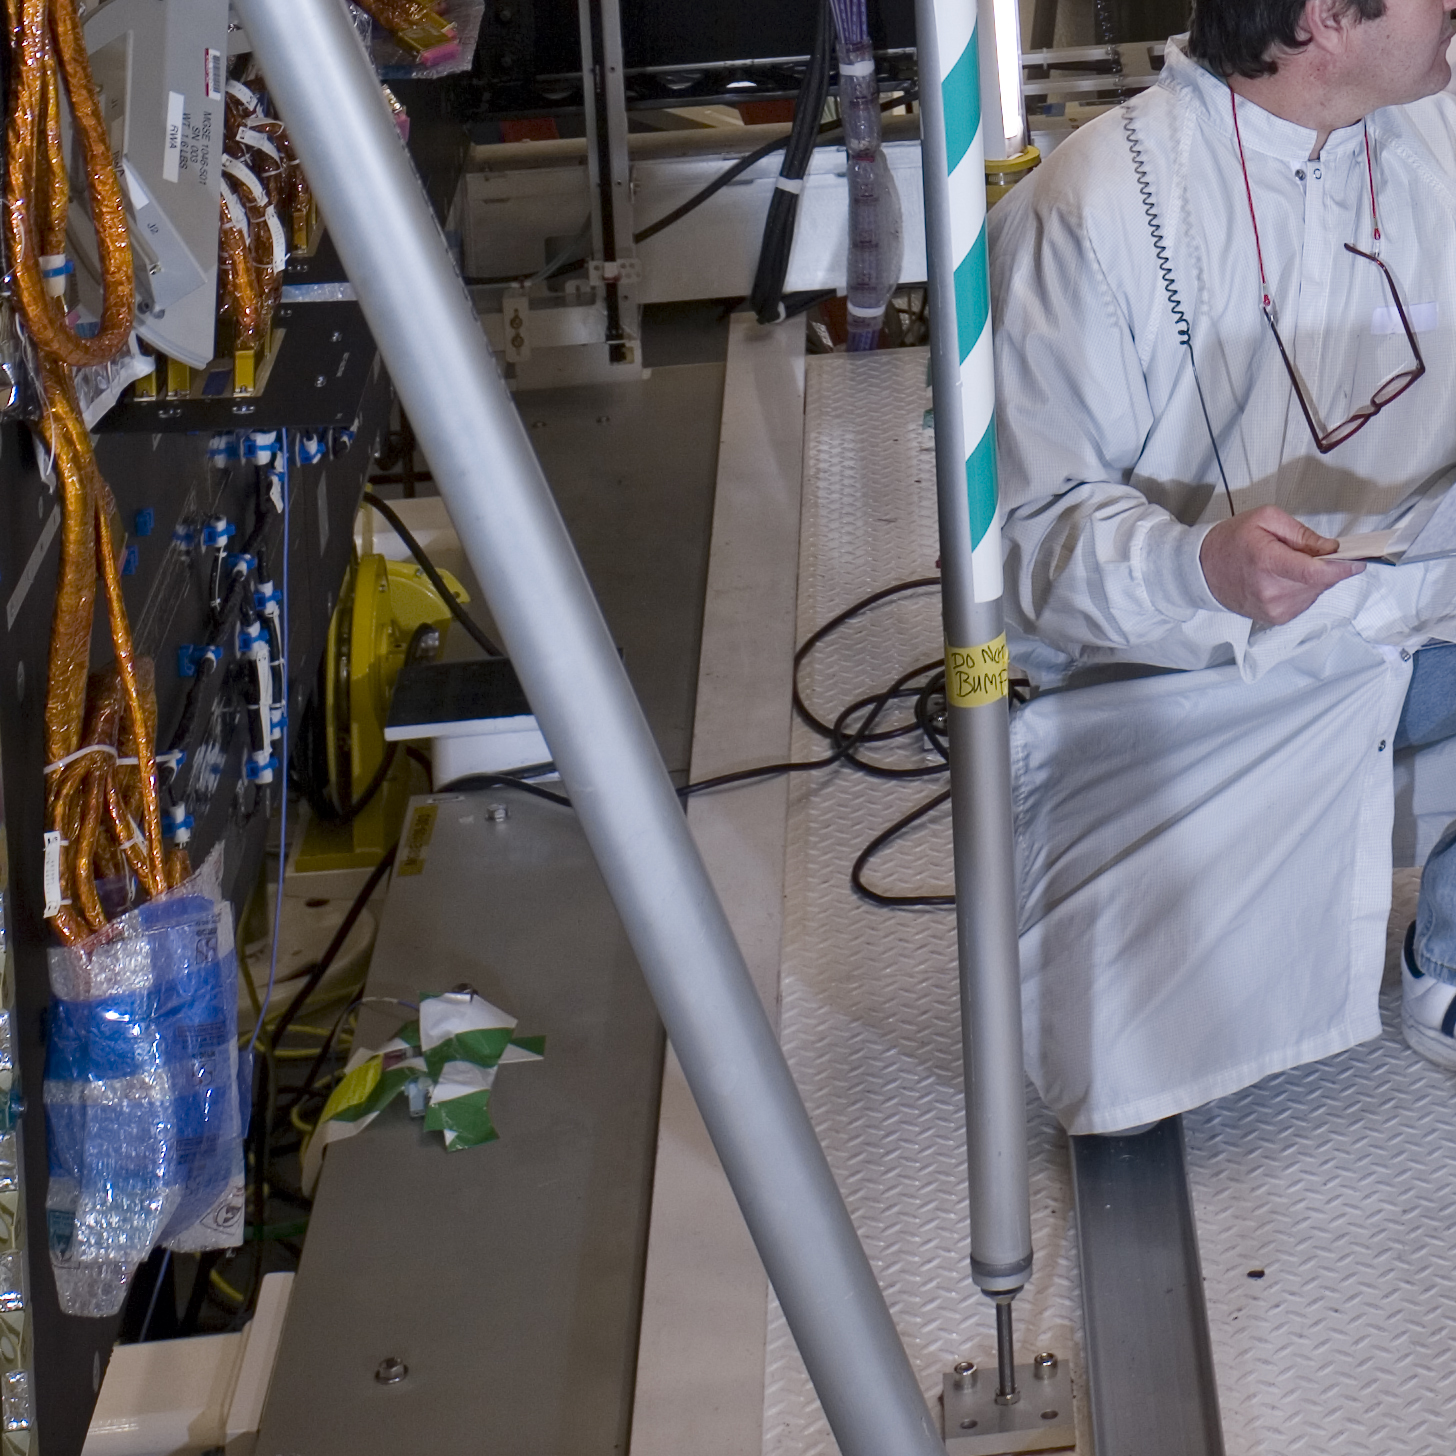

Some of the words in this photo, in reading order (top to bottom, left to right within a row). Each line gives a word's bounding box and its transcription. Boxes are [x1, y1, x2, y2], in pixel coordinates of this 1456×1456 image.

[169, 124, 179, 149] RWA
[191, 125, 200, 142] SN
[201, 110, 212, 142] MGSE
[179, 149, 188, 170] LBS
[951, 652, 975, 670] DO
[954, 668, 1008, 698] BUMP
